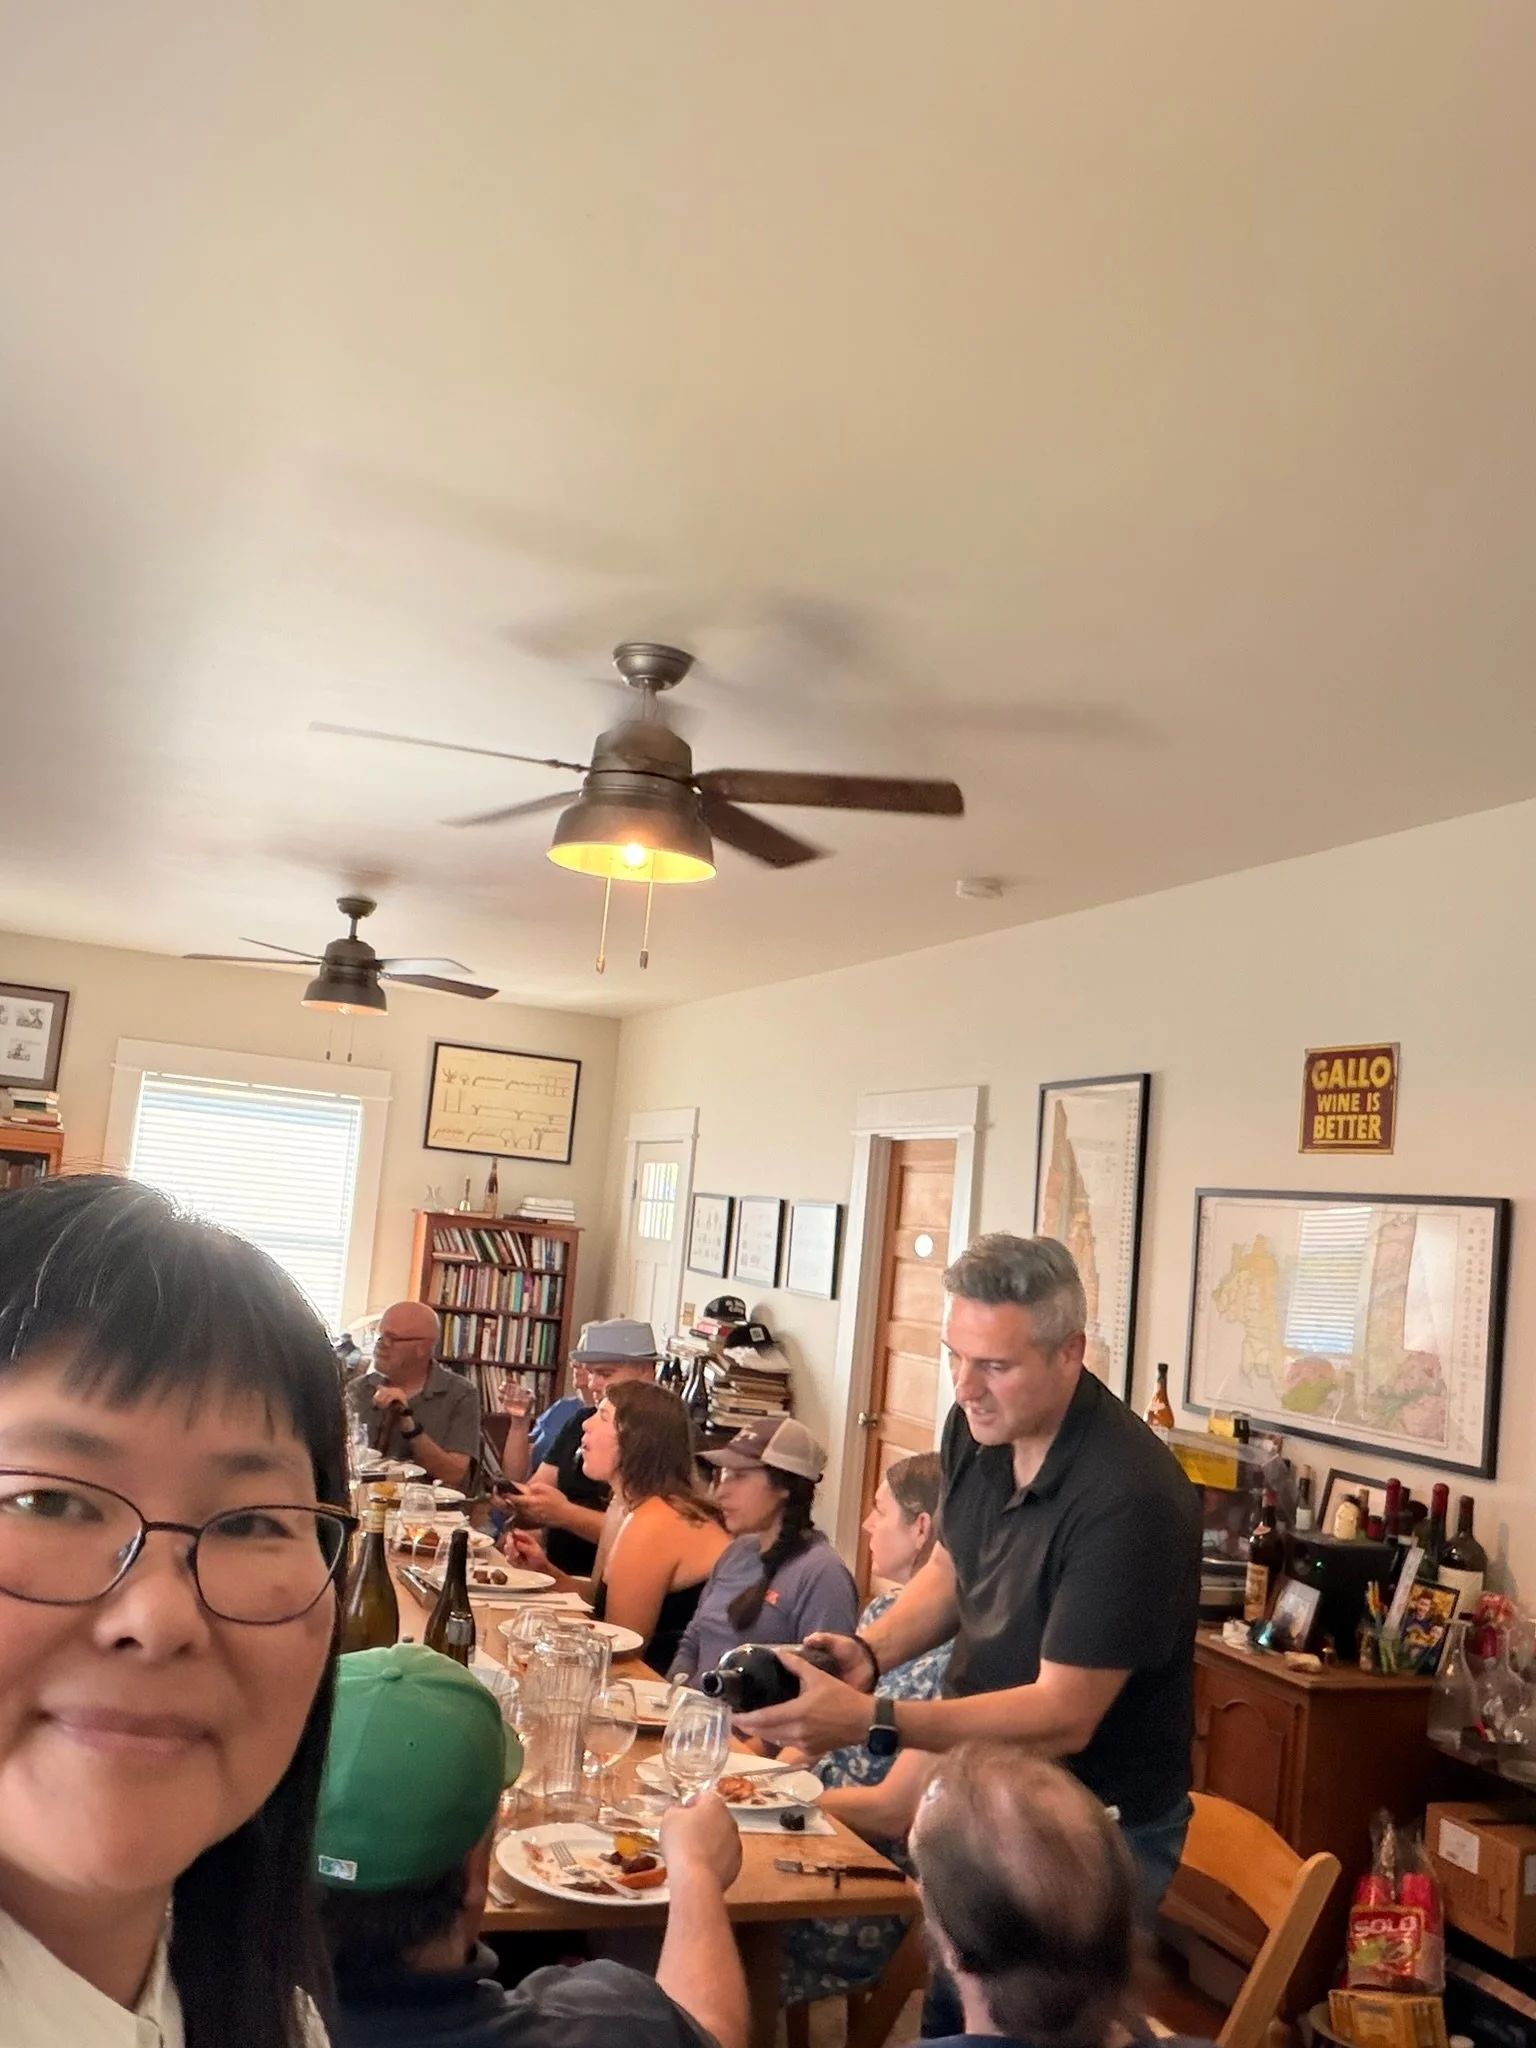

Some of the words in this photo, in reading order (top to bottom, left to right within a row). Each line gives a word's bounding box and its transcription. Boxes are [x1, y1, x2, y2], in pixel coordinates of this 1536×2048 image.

[1311, 1055, 1392, 1091] GALLO
[1317, 1092, 1361, 1113] WINE
[1366, 1092, 1381, 1113] IS
[1312, 1114, 1382, 1140] BETTER
[1354, 1915, 1418, 1937] SOLO
